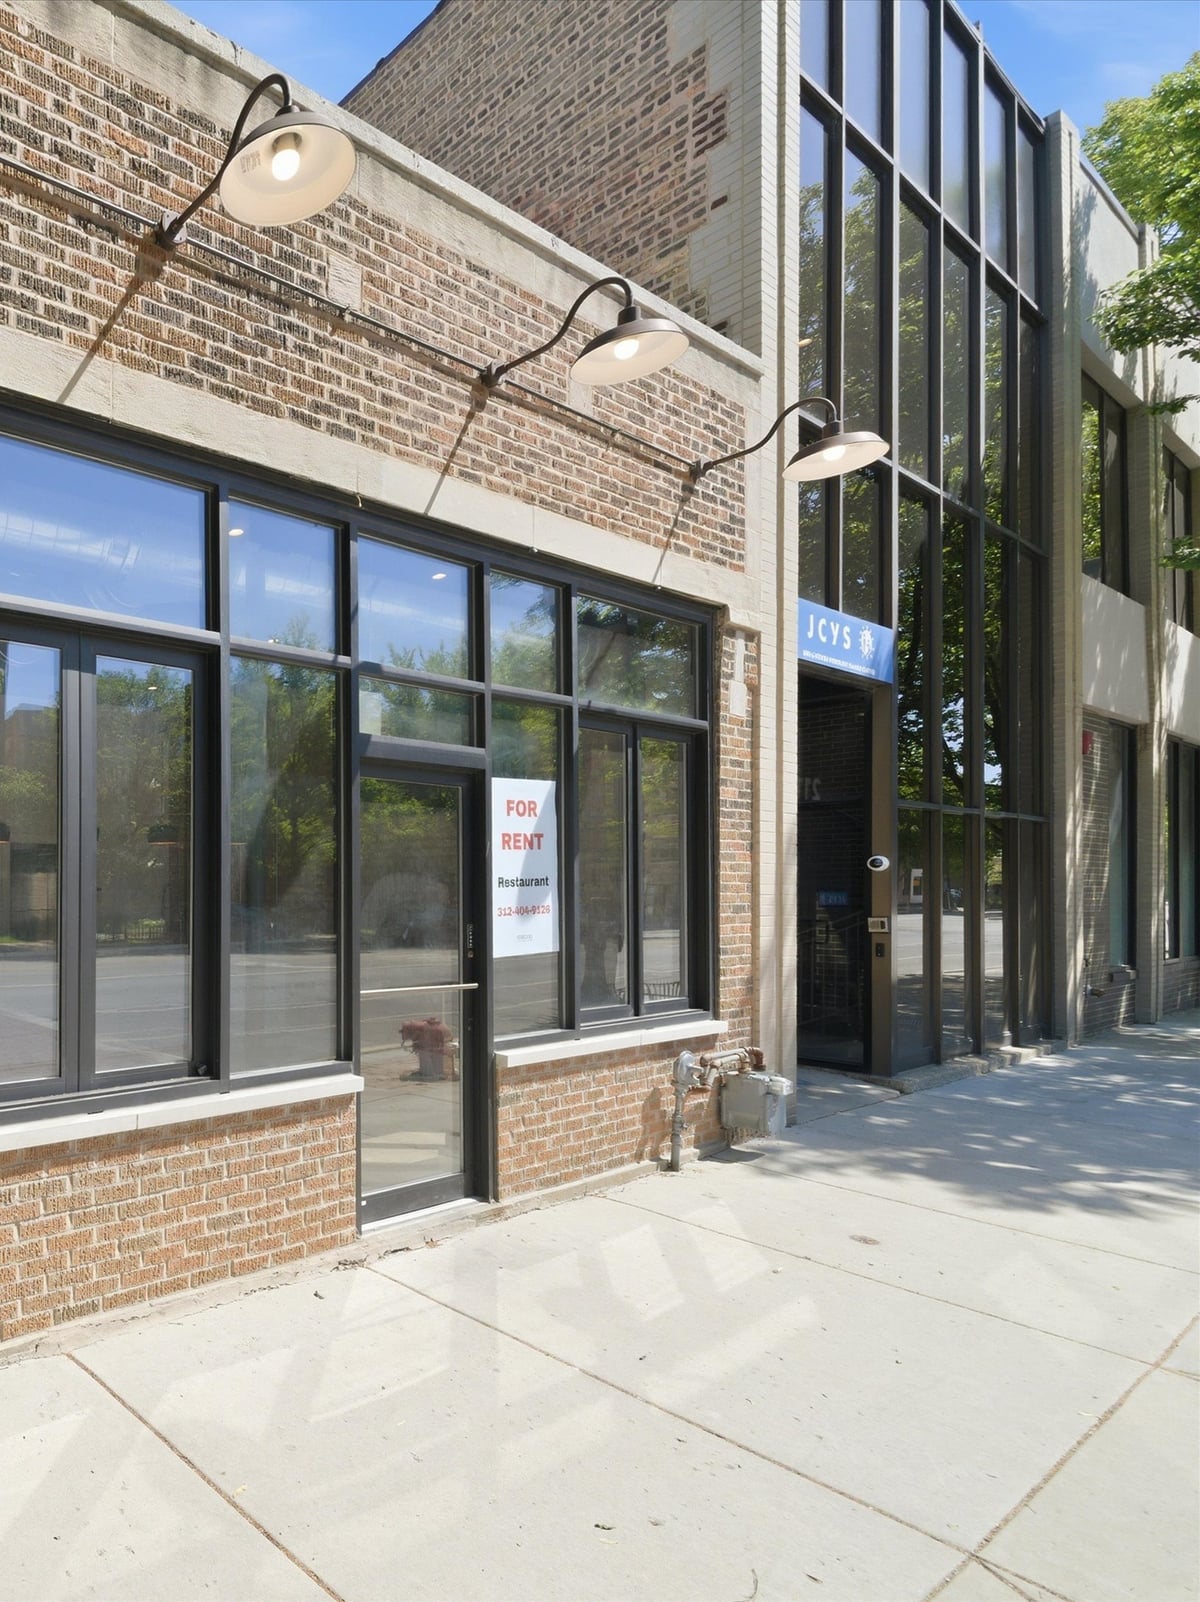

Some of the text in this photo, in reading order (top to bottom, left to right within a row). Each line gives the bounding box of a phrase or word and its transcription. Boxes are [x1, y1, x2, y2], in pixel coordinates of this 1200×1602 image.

[807, 613, 852, 650] JCYS
[506, 799, 538, 818] FOR
[501, 832, 544, 851] RENT
[498, 876, 550, 889] Restaurant
